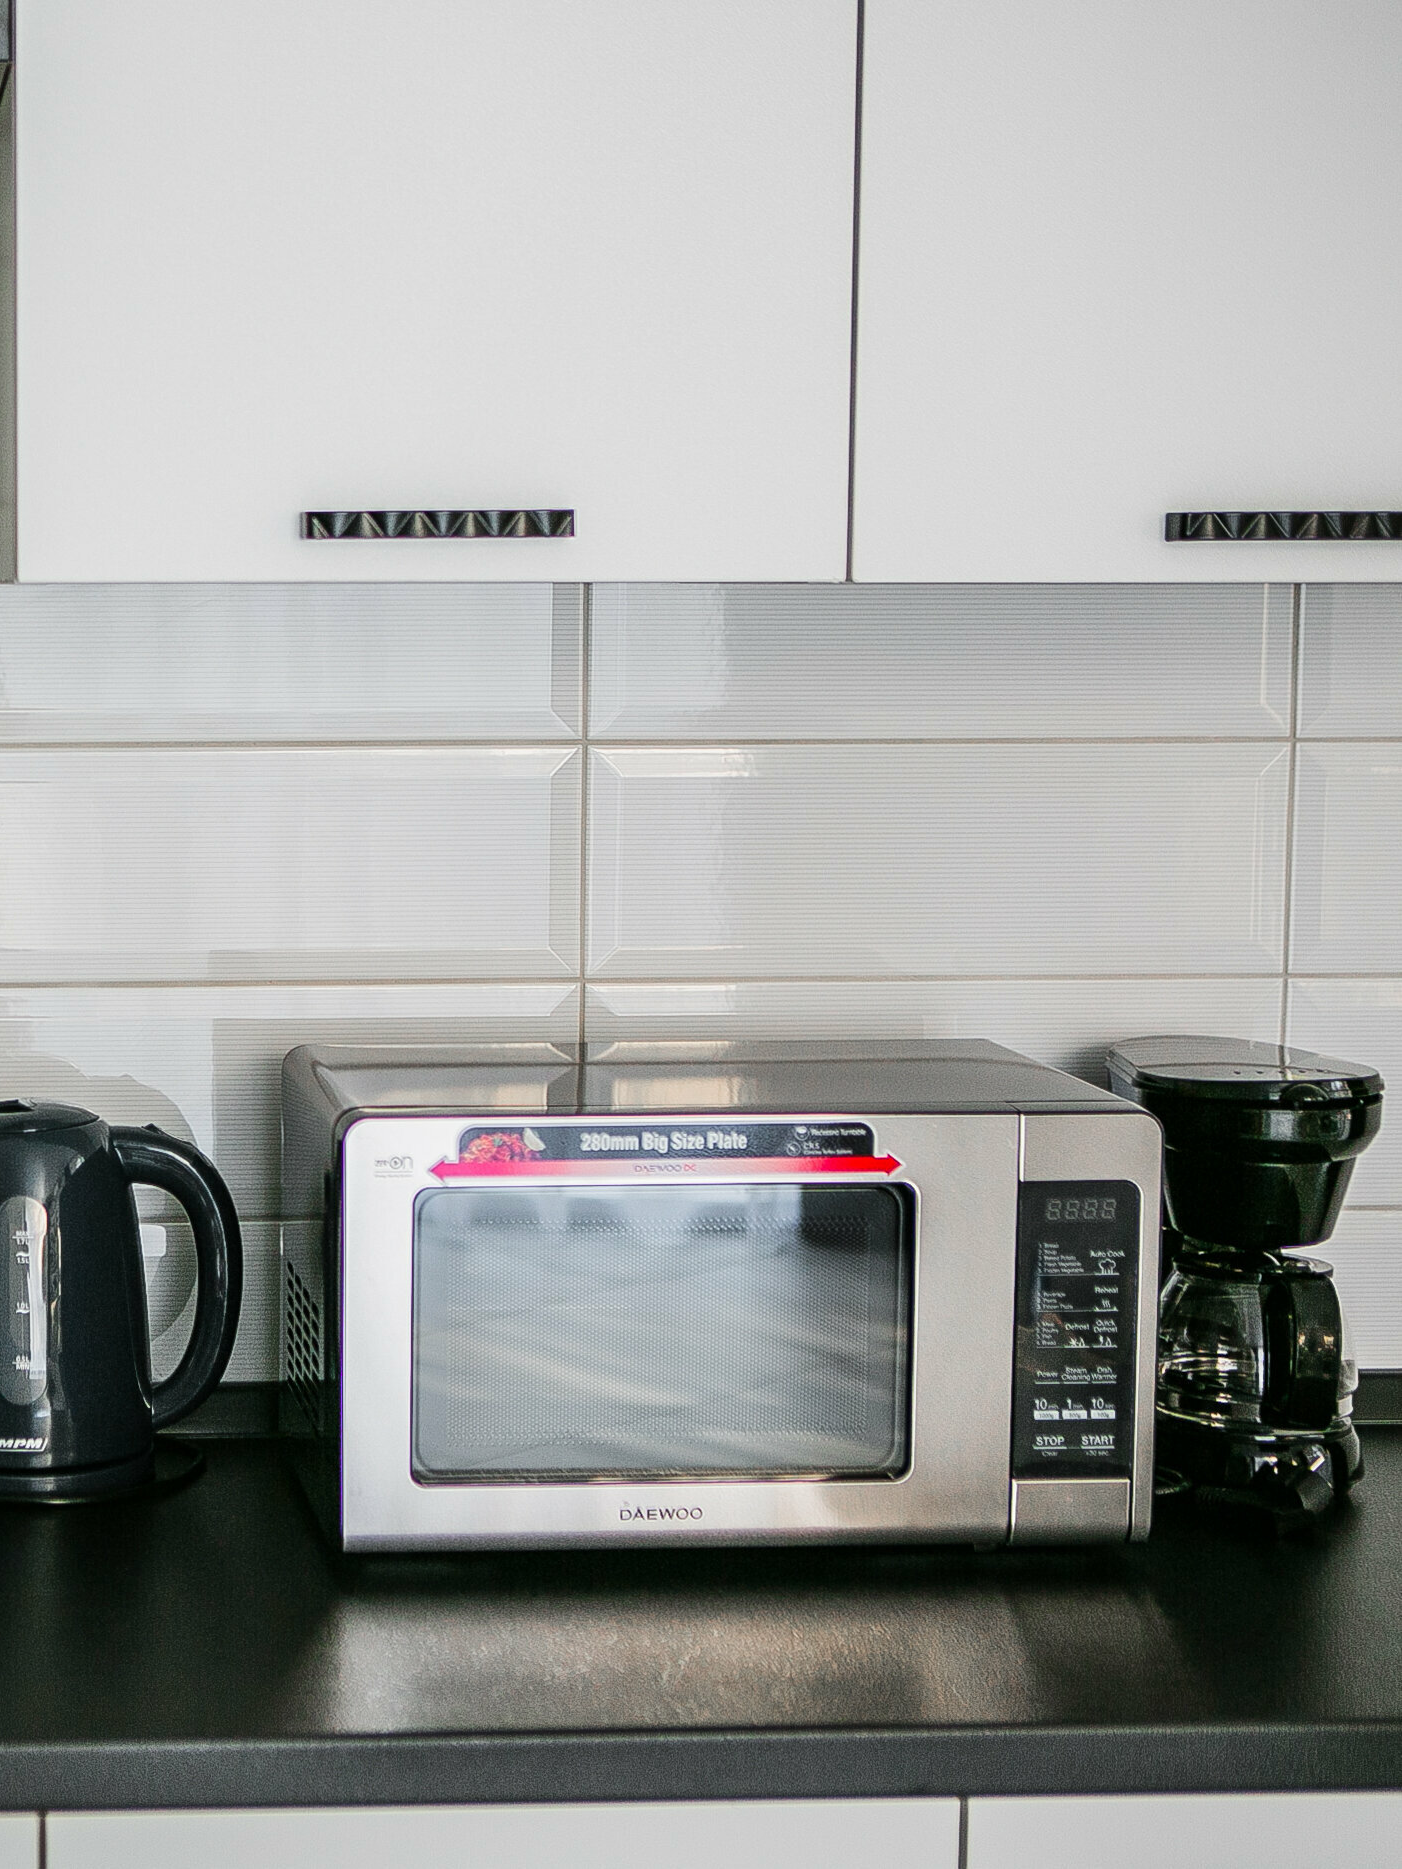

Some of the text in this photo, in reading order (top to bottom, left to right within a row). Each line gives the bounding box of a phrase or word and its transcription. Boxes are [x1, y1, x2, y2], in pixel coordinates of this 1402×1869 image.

[580, 1130, 748, 1154] 280mm Big Size Plate
[634, 1164, 683, 1173] DAEWOO
[1107, 1249, 1126, 1258] Cook
[1061, 1373, 1091, 1381] Cleaning
[1034, 1398, 1048, 1410] 10
[1066, 1398, 1072, 1410] 1
[1091, 1397, 1105, 1410] 10
[1035, 1435, 1065, 1446] STOP
[1081, 1434, 1116, 1446] START
[619, 1506, 704, 1522] DAEWOO
